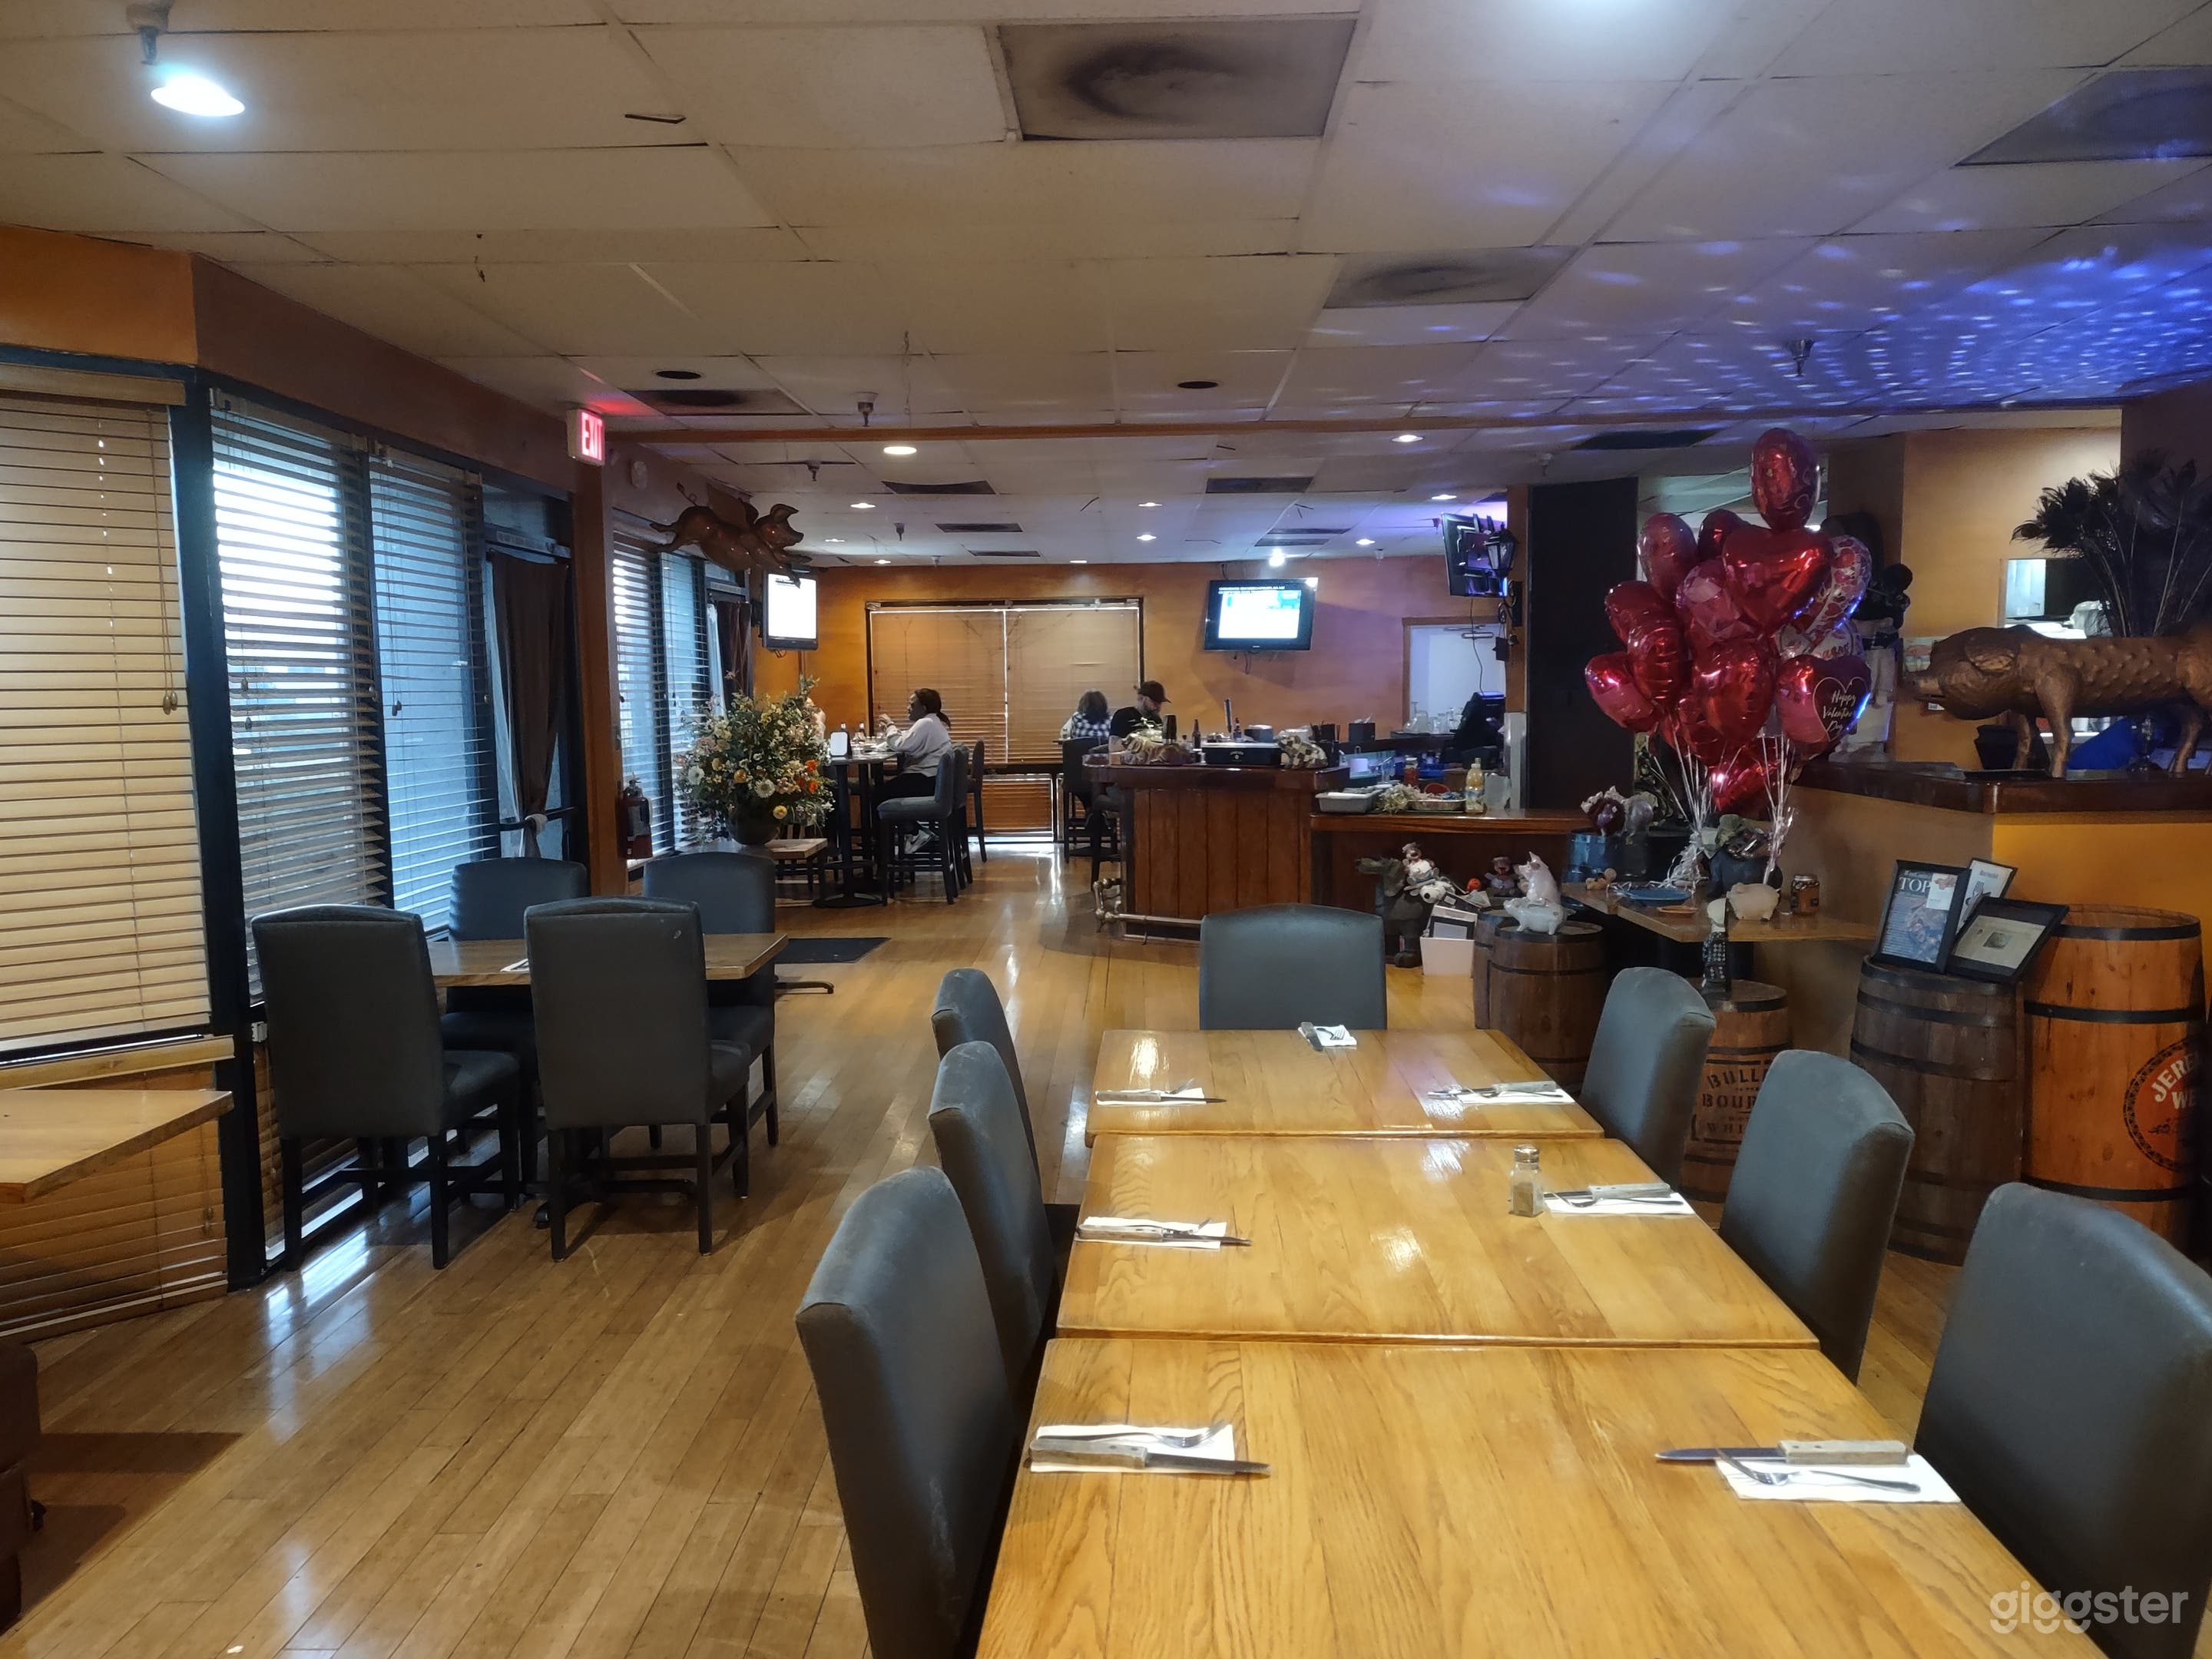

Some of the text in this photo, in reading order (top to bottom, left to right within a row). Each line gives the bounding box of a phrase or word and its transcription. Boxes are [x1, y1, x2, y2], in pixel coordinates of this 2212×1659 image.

[581, 412, 603, 461] EXIT
[1831, 690, 1856, 706] Happy
[1826, 720, 1843, 732] Day
[1899, 876, 1931, 893] TOP
